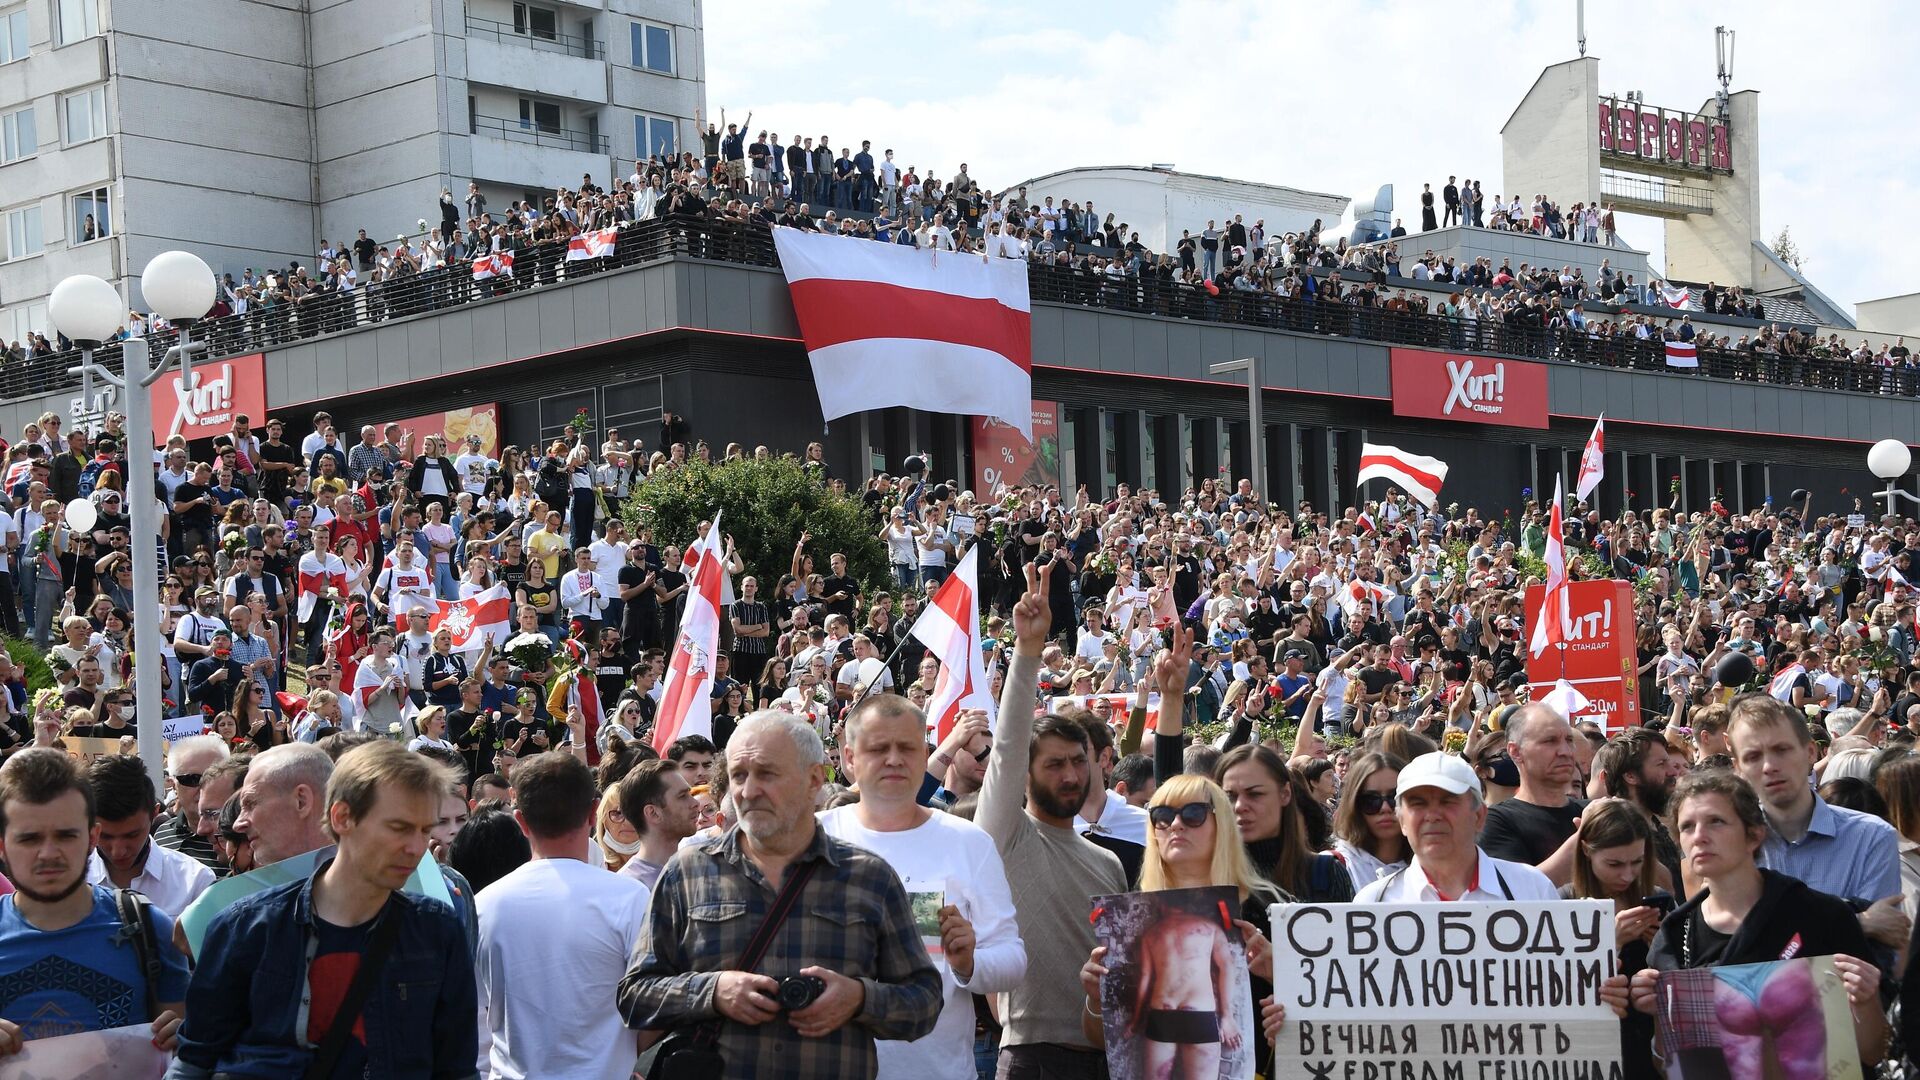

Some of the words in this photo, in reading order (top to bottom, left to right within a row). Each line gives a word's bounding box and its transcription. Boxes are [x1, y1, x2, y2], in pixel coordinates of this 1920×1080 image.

[1598, 103, 1730, 168] АВРОРА
[170, 363, 233, 436] Хит!
[1443, 360, 1505, 415] Хит!
[1473, 403, 1503, 414] СТАНДАРТ
[200, 413, 232, 427] СТАНДАРТ
[1571, 641, 1610, 652] СТАНДАРТ
[162, 729, 200, 742] ЧЕННЫМ
[1287, 906, 1601, 957] СВОБОДУ
[1297, 949, 1614, 1008] ЗАКЛЮЧЕННЫМ!
[1299, 1020, 1418, 1056] ВЕЧНАЯ
[1441, 1022, 1571, 1056] ПАМЯТЬ
